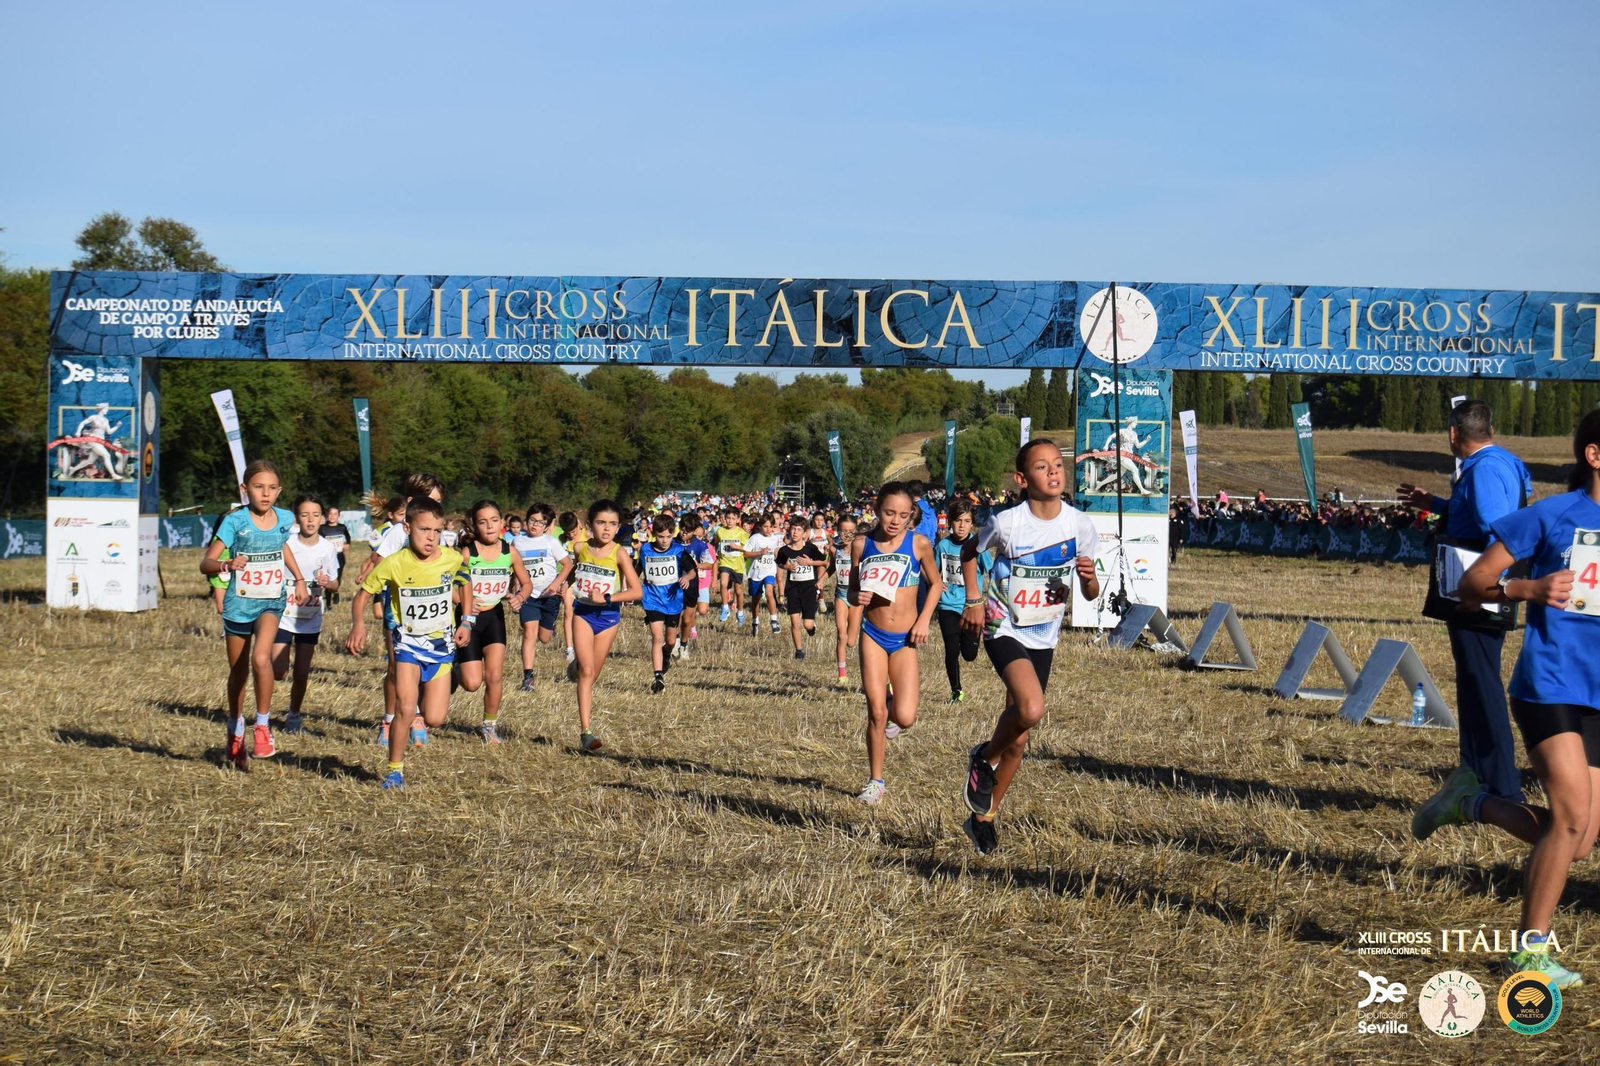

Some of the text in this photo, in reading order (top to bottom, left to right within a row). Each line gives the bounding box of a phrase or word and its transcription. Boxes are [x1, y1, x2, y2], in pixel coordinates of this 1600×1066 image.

[65, 297, 284, 313] CAMPEONATO DE ANDALUCÍA
[345, 288, 628, 339] XLIII CROSS
[683, 278, 985, 349] ITÁLICA
[99, 311, 251, 327] DE CAMPO A TRAVÉS
[1201, 295, 1492, 350] XLIII CROSS
[133, 327, 221, 340] POR CLUBES
[505, 323, 673, 340] INTERNACIONAL
[343, 343, 643, 361] INTERNATIONAL CROSS COUNTRY
[1366, 335, 1537, 355] INTERNACIONAL
[1200, 351, 1507, 374] INTERNATIONAL CROSS COUNTRY
[96, 373, 130, 383] Sevilla
[1126, 387, 1160, 396] Sevilla
[240, 569, 283, 586] 4379
[648, 565, 675, 577] 4100
[791, 566, 812, 575] 229
[860, 567, 900, 587] 4370
[473, 580, 507, 595] 4349
[406, 600, 449, 620] 4293
